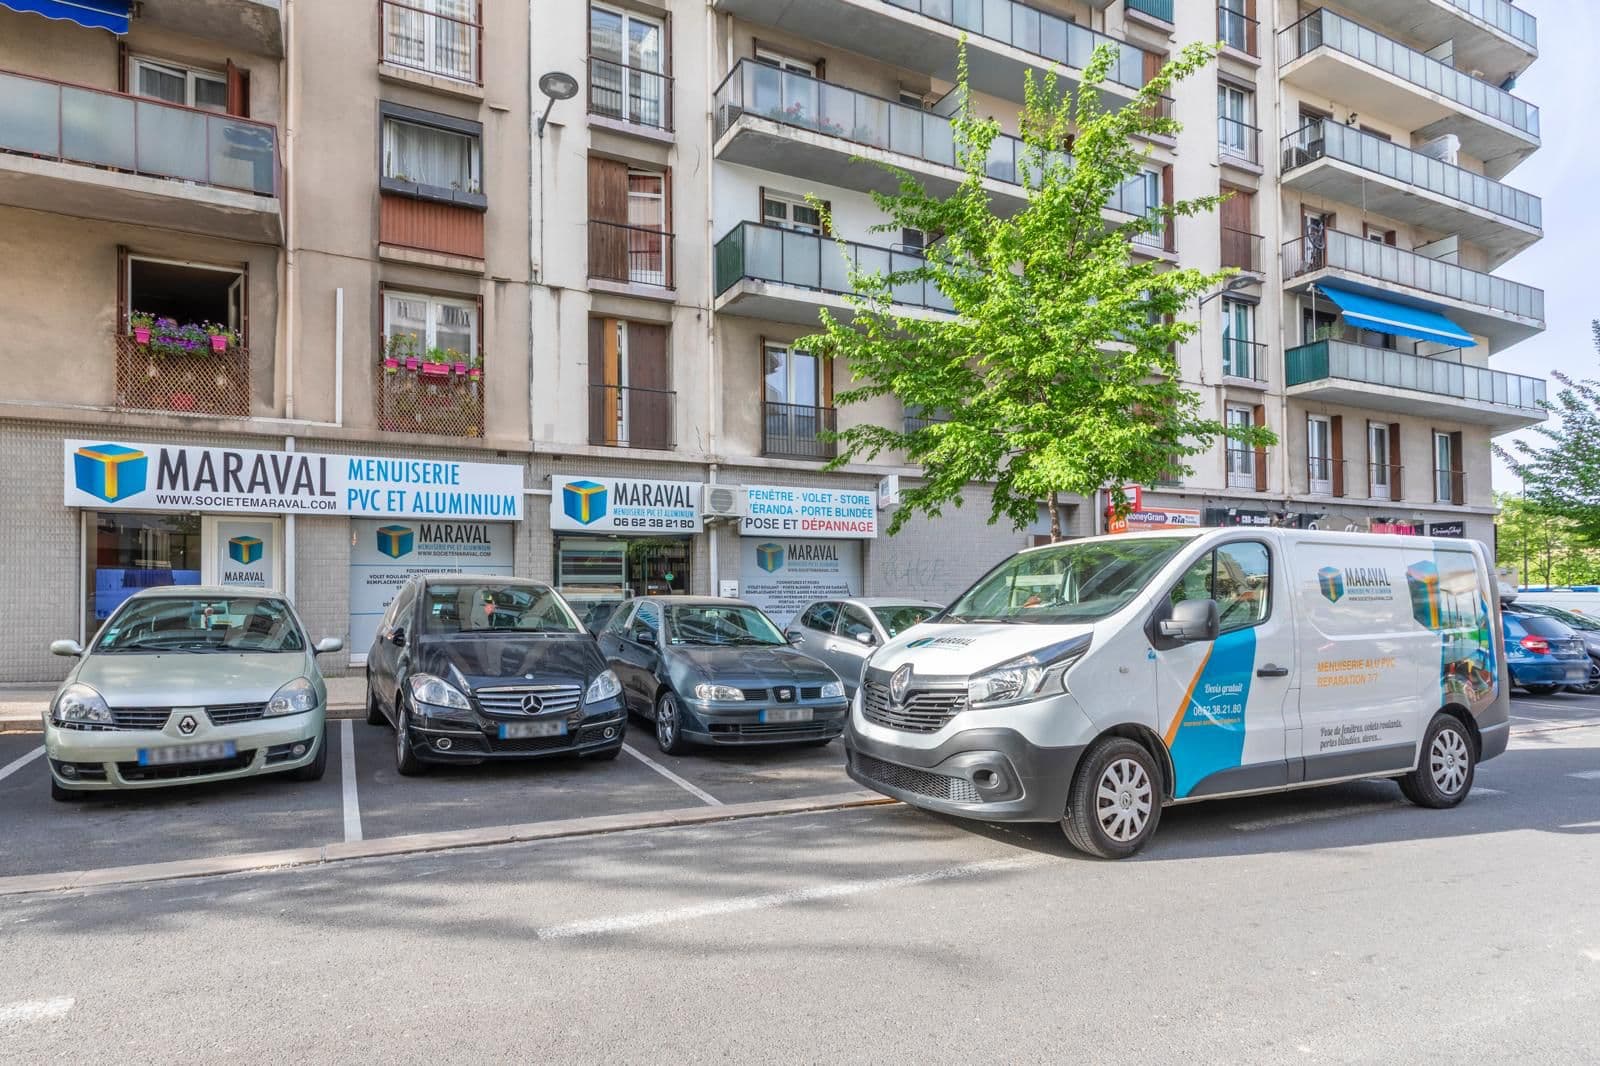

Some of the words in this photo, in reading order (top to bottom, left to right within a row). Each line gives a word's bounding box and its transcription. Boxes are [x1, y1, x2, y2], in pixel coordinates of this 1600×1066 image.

[156, 448, 336, 496] MARAVAL
[348, 458, 460, 485] MENUISERIE
[156, 494, 337, 510] WWW.SOCIETEMARAVAL.COM
[348, 488, 380, 511] PVC
[388, 490, 406, 512] ET
[412, 491, 516, 516] ALUMINIUM
[614, 482, 694, 508] MARAVAL
[749, 489, 794, 501] FENÊTRE
[802, 493, 832, 503] VOLET
[840, 494, 870, 505] STORE
[801, 506, 832, 517] PORTE
[835, 507, 872, 518] BLINDÉE
[1126, 513, 1164, 522] MoneyGram
[614, 518, 629, 526] 06
[631, 518, 646, 527] 62
[649, 519, 663, 528] 38
[666, 519, 678, 528] 21
[680, 520, 694, 528] 80
[746, 518, 779, 529] POSE
[784, 519, 798, 529] ET
[802, 518, 874, 532] DÉPANNAGE
[419, 524, 490, 543] MARAVAL
[788, 544, 838, 560] MARAVAL
[224, 572, 264, 581] MARAVAL
[1345, 568, 1391, 586] MARAVAL
[1317, 659, 1363, 672] MENUISERIE
